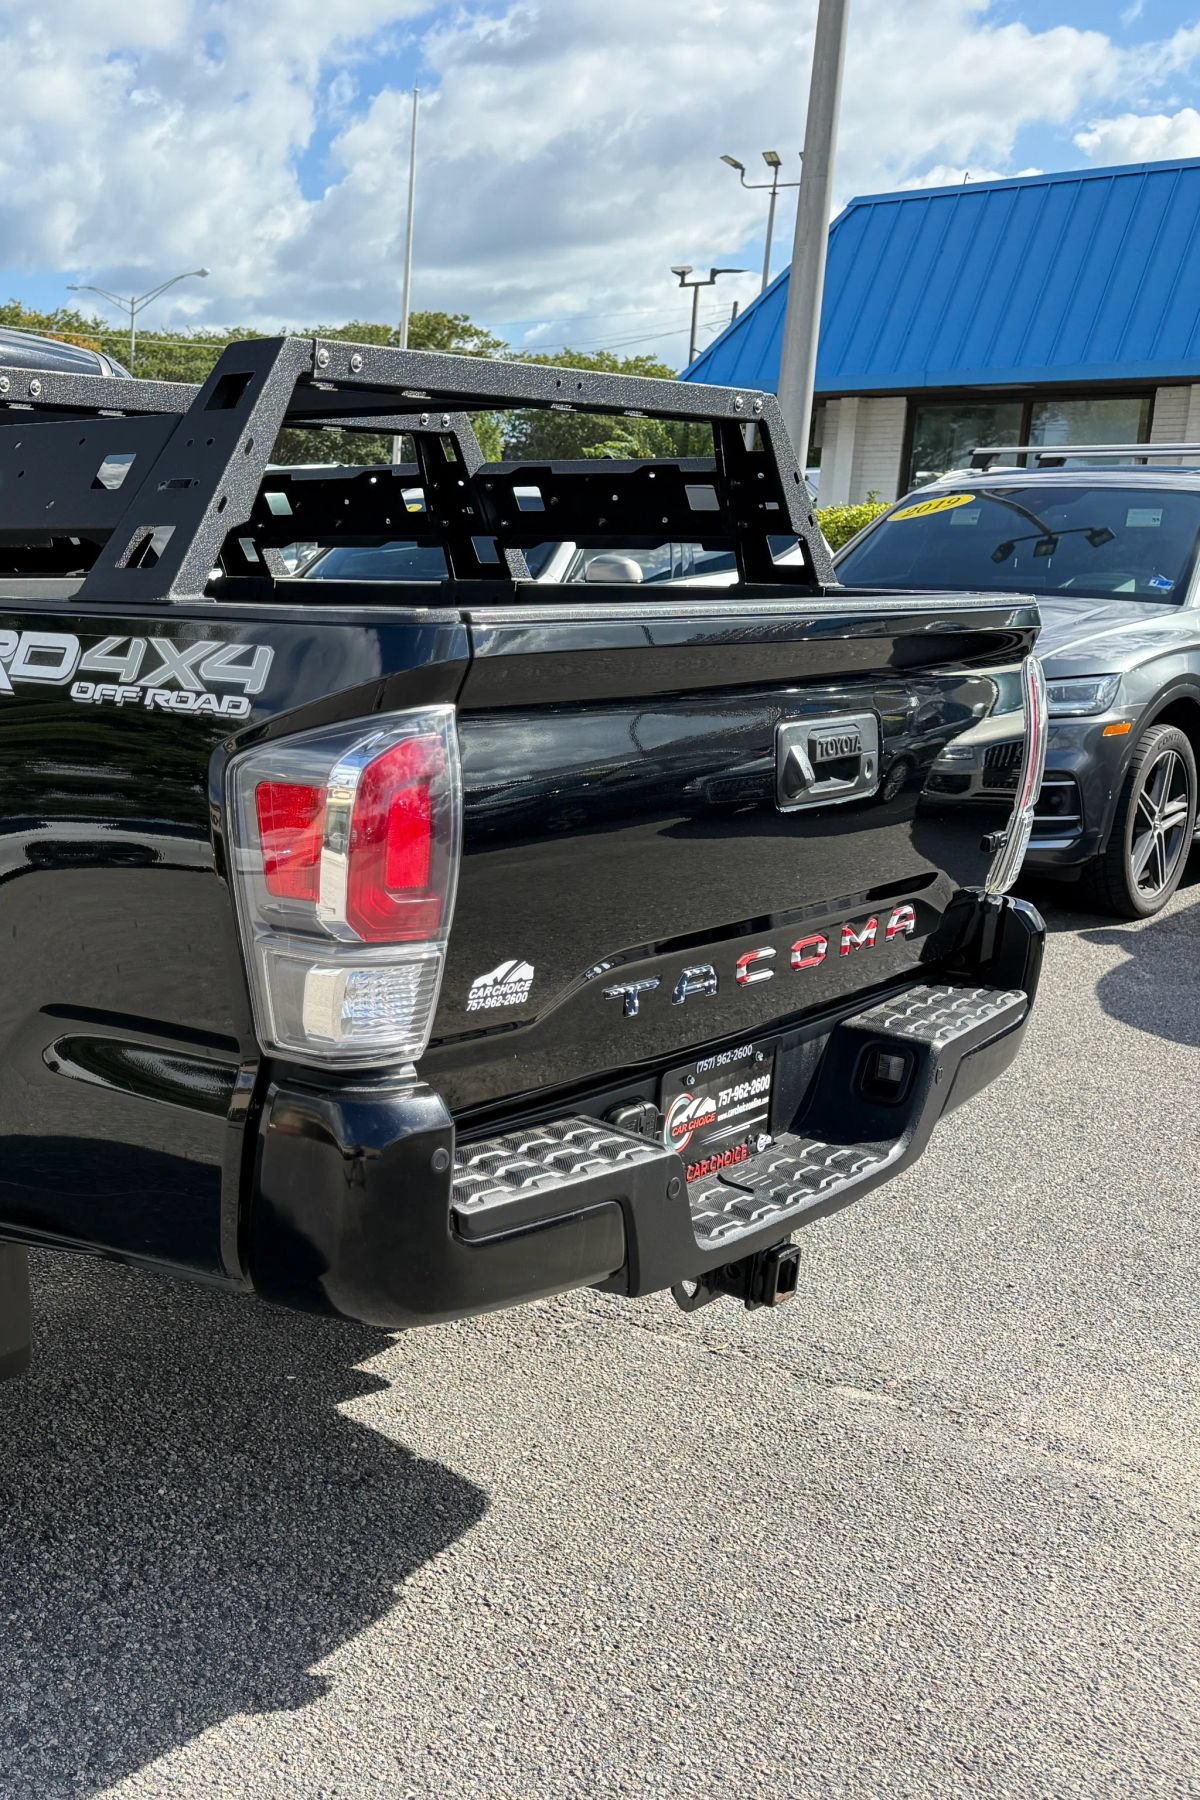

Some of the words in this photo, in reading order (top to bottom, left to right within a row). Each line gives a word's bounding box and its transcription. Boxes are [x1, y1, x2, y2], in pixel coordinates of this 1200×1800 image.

[901, 497, 961, 518] 2019
[79, 636, 275, 695] 4X4
[70, 681, 142, 707] OFF
[144, 688, 252, 719] ROAD
[817, 734, 862, 758] TOYOTA
[602, 904, 917, 1018] TACOMA
[466, 991, 529, 1012] 757-962-2600
[696, 1055, 715, 1074] (757)
[716, 1044, 753, 1067] 962-2600
[718, 1073, 770, 1108] 757-962-2600
[671, 1122, 688, 1137] CAR
[688, 1112, 717, 1131] CHOICE
[686, 1159, 709, 1183] CAR
[710, 1143, 749, 1173] CHOICE
